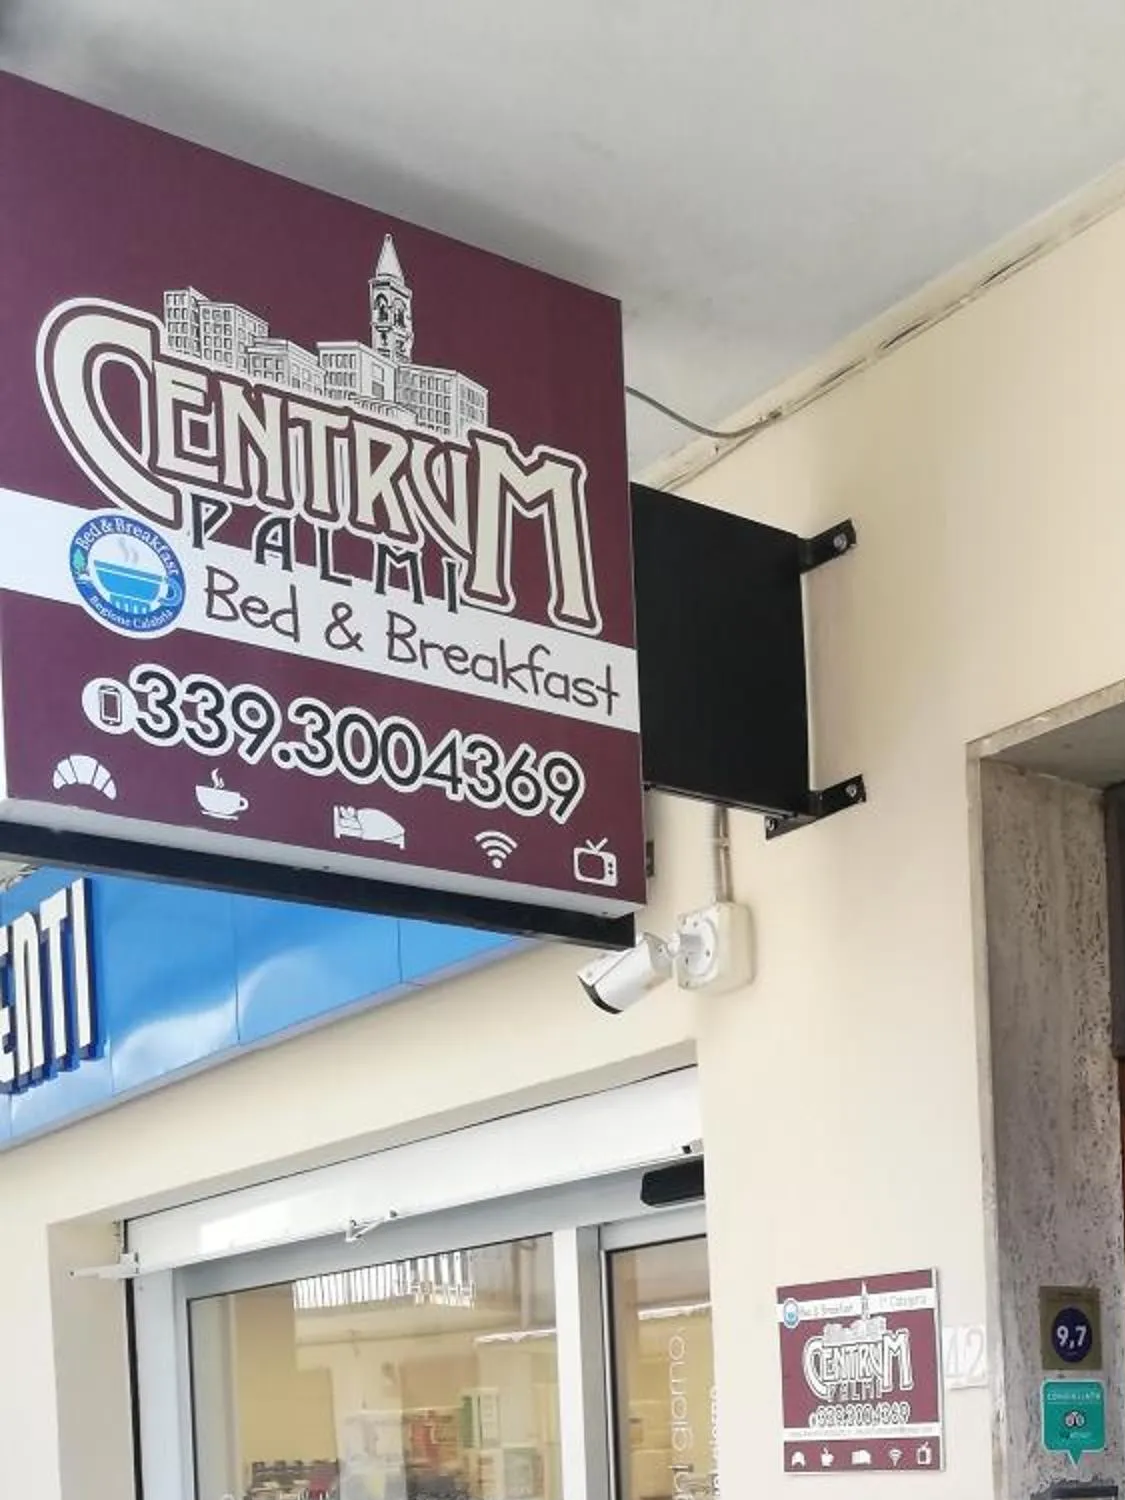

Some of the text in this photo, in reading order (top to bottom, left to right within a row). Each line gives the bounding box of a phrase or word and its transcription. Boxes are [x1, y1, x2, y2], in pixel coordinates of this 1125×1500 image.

[191, 495, 461, 613] PALMI
[205, 565, 621, 717] Bed & Breakfast
[134, 670, 584, 820] 339.3004369
[1056, 1325, 1088, 1350] 9,7
